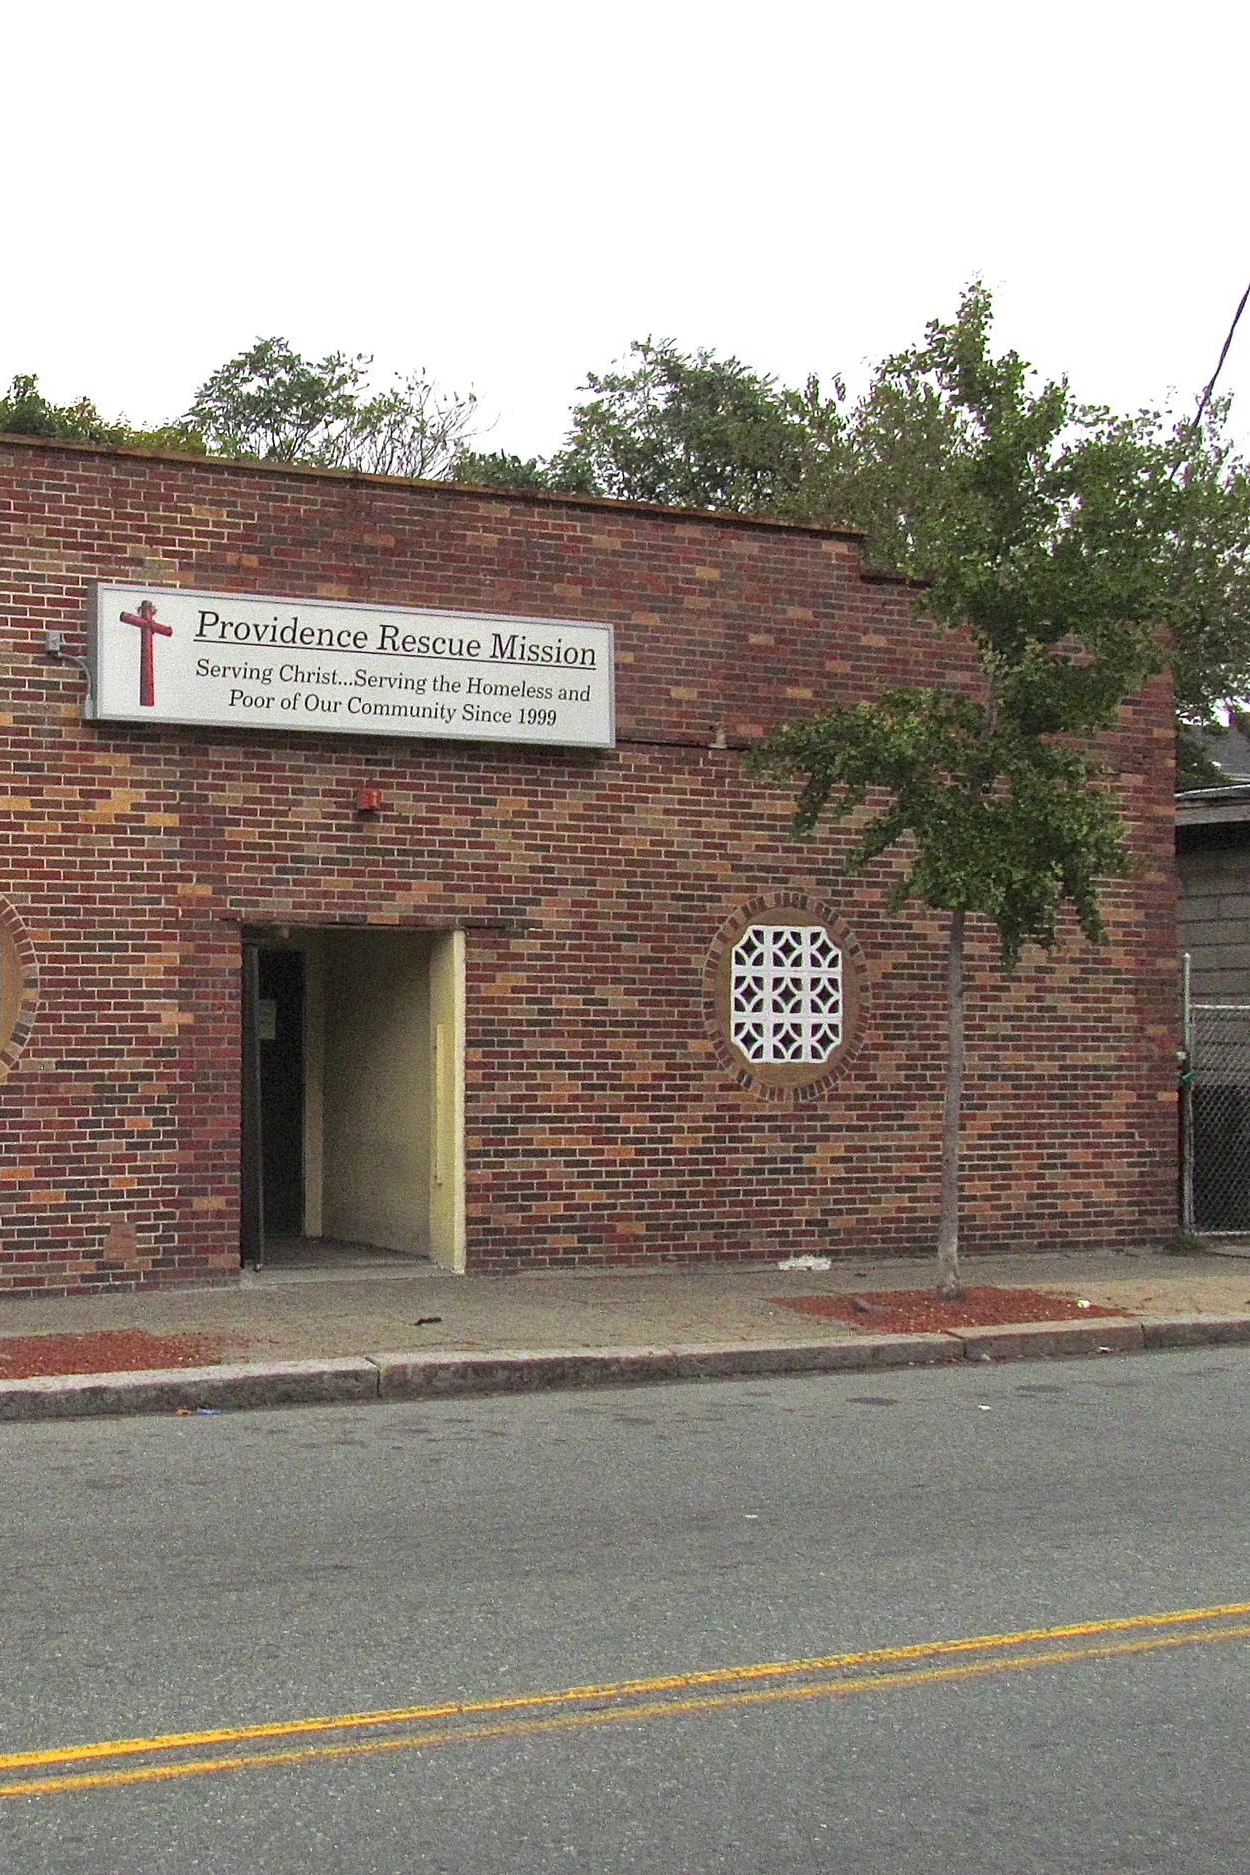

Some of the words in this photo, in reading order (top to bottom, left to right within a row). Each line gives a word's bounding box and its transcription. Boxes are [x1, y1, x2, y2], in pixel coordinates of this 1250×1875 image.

[195, 610, 368, 649] Providence
[376, 624, 481, 657] Rescue
[489, 632, 596, 666] Mission
[195, 658, 274, 685] Serving
[432, 674, 462, 694] the
[465, 676, 553, 700] Homeless
[557, 685, 591, 702] and
[228, 688, 275, 709] Poor
[280, 692, 301, 710] of
[304, 693, 342, 713] Our
[347, 696, 457, 724] Community
[461, 703, 512, 723] Since
[517, 707, 557, 726] 1999
